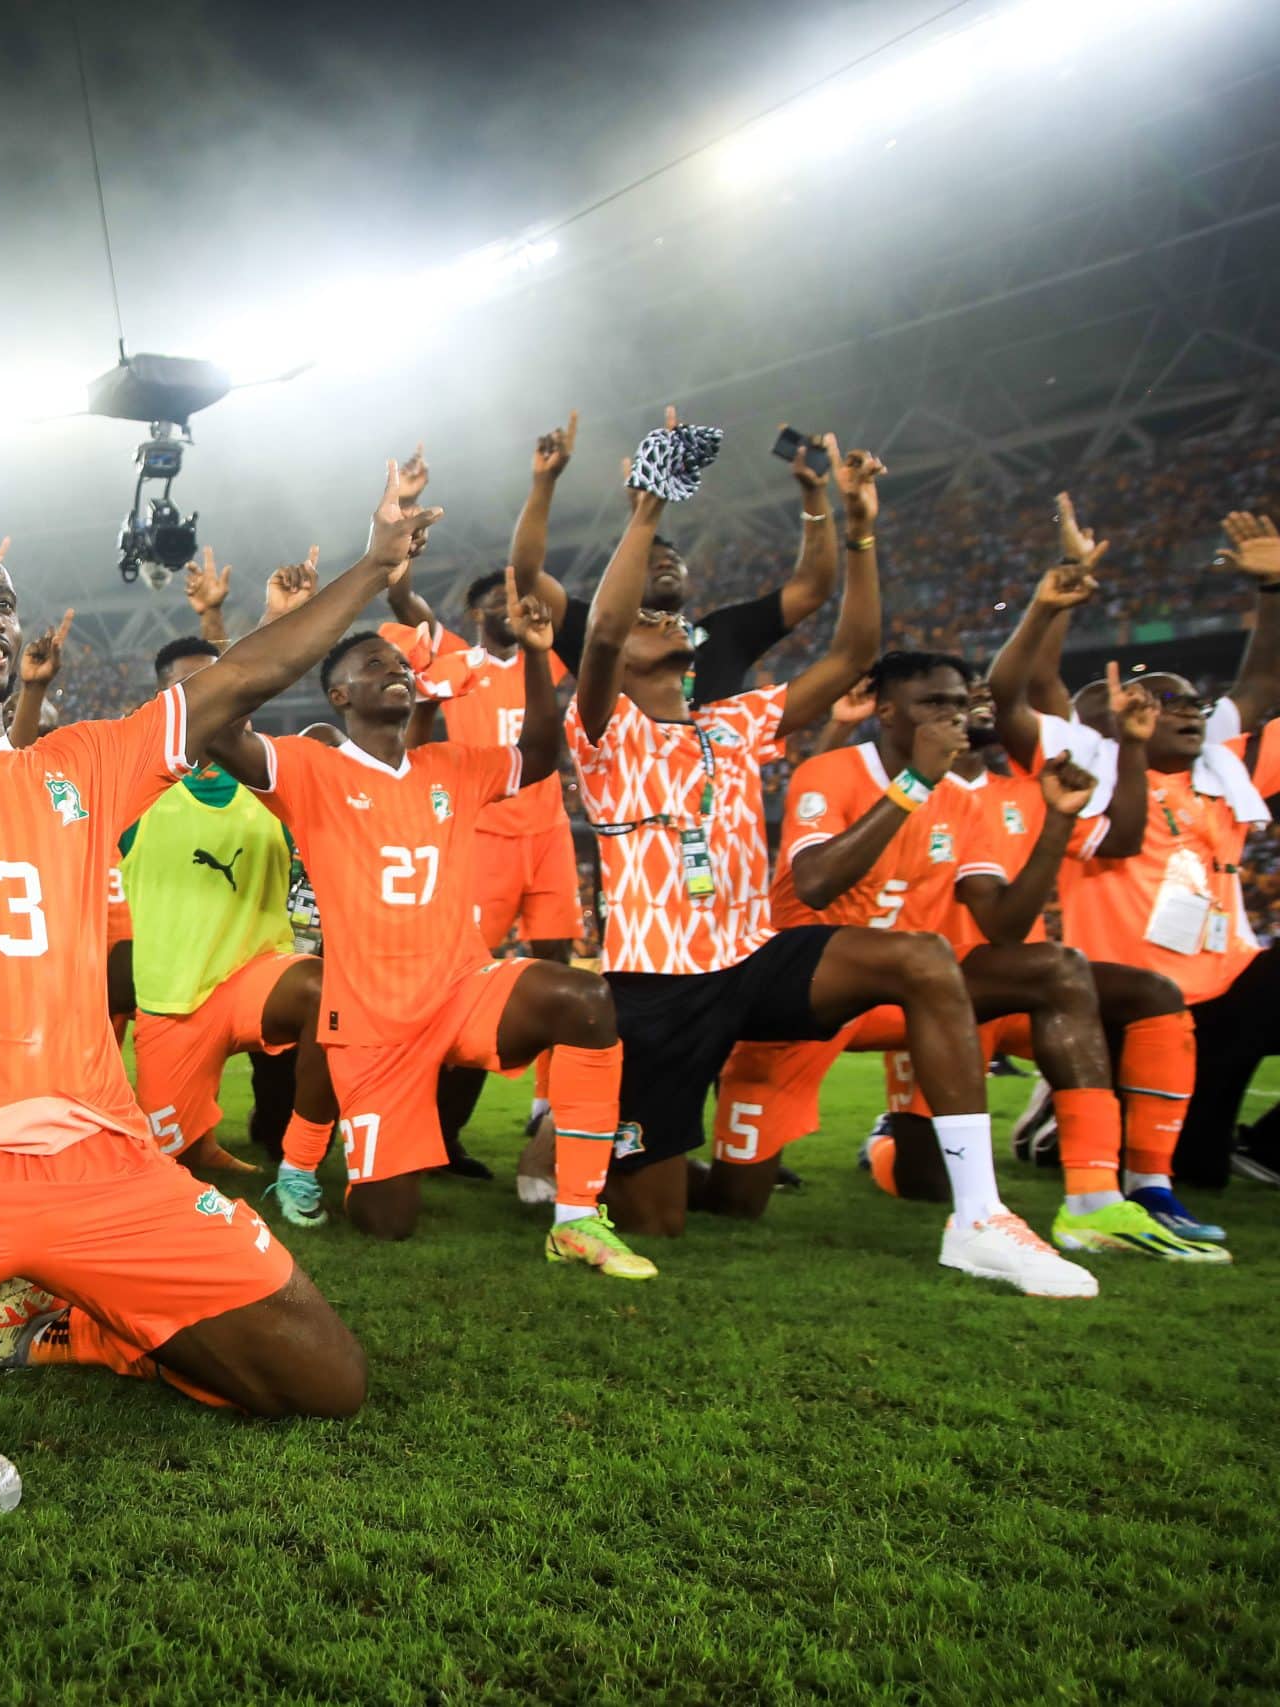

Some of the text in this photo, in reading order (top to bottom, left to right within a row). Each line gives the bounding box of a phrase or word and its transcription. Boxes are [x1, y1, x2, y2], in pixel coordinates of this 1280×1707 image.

[497, 707, 526, 747] 18
[380, 845, 440, 906] 27
[868, 879, 909, 929] 5
[149, 1103, 185, 1154] 5
[339, 1112, 381, 1180] 27
[725, 1101, 763, 1160] 5
